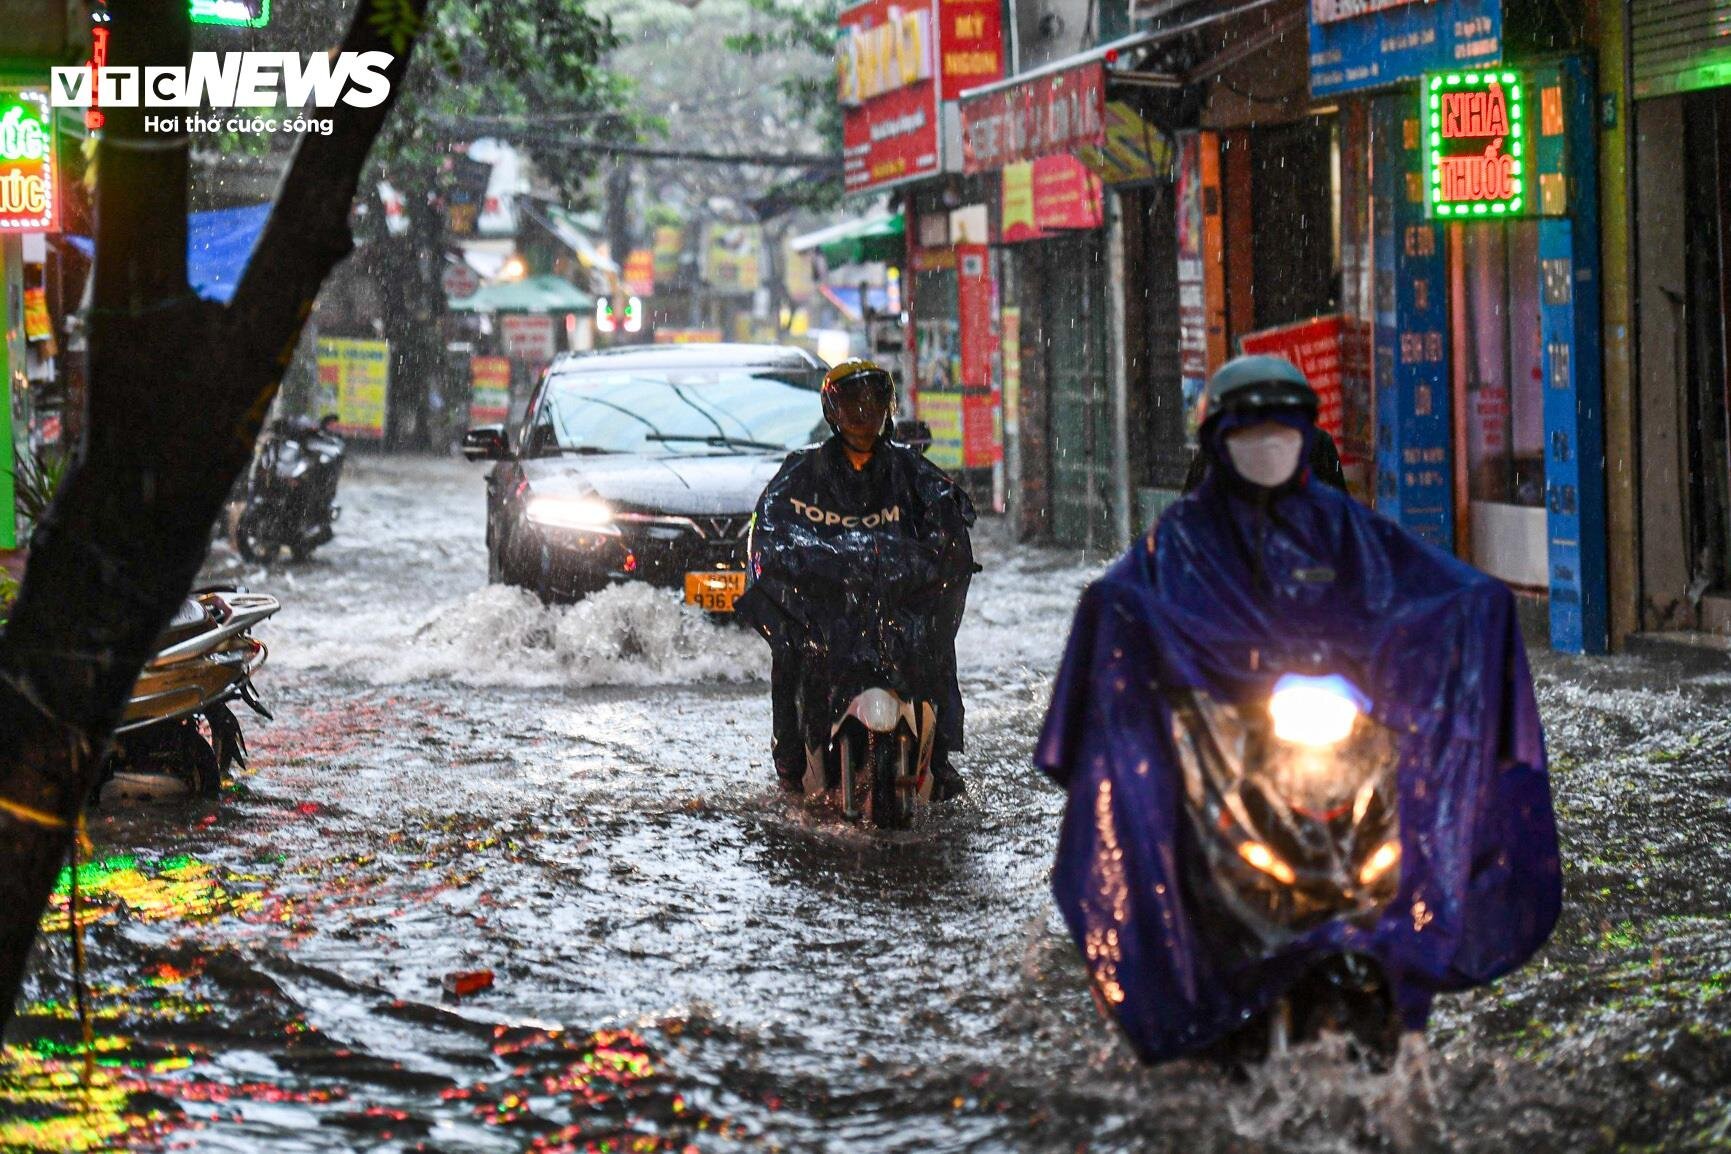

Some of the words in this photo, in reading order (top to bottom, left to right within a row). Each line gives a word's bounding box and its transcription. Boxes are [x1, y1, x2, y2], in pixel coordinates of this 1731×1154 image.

[1442, 82, 1509, 137] NHÀ
[1439, 138, 1515, 201] THUỐC
[789, 497, 901, 529] TOPCOM
